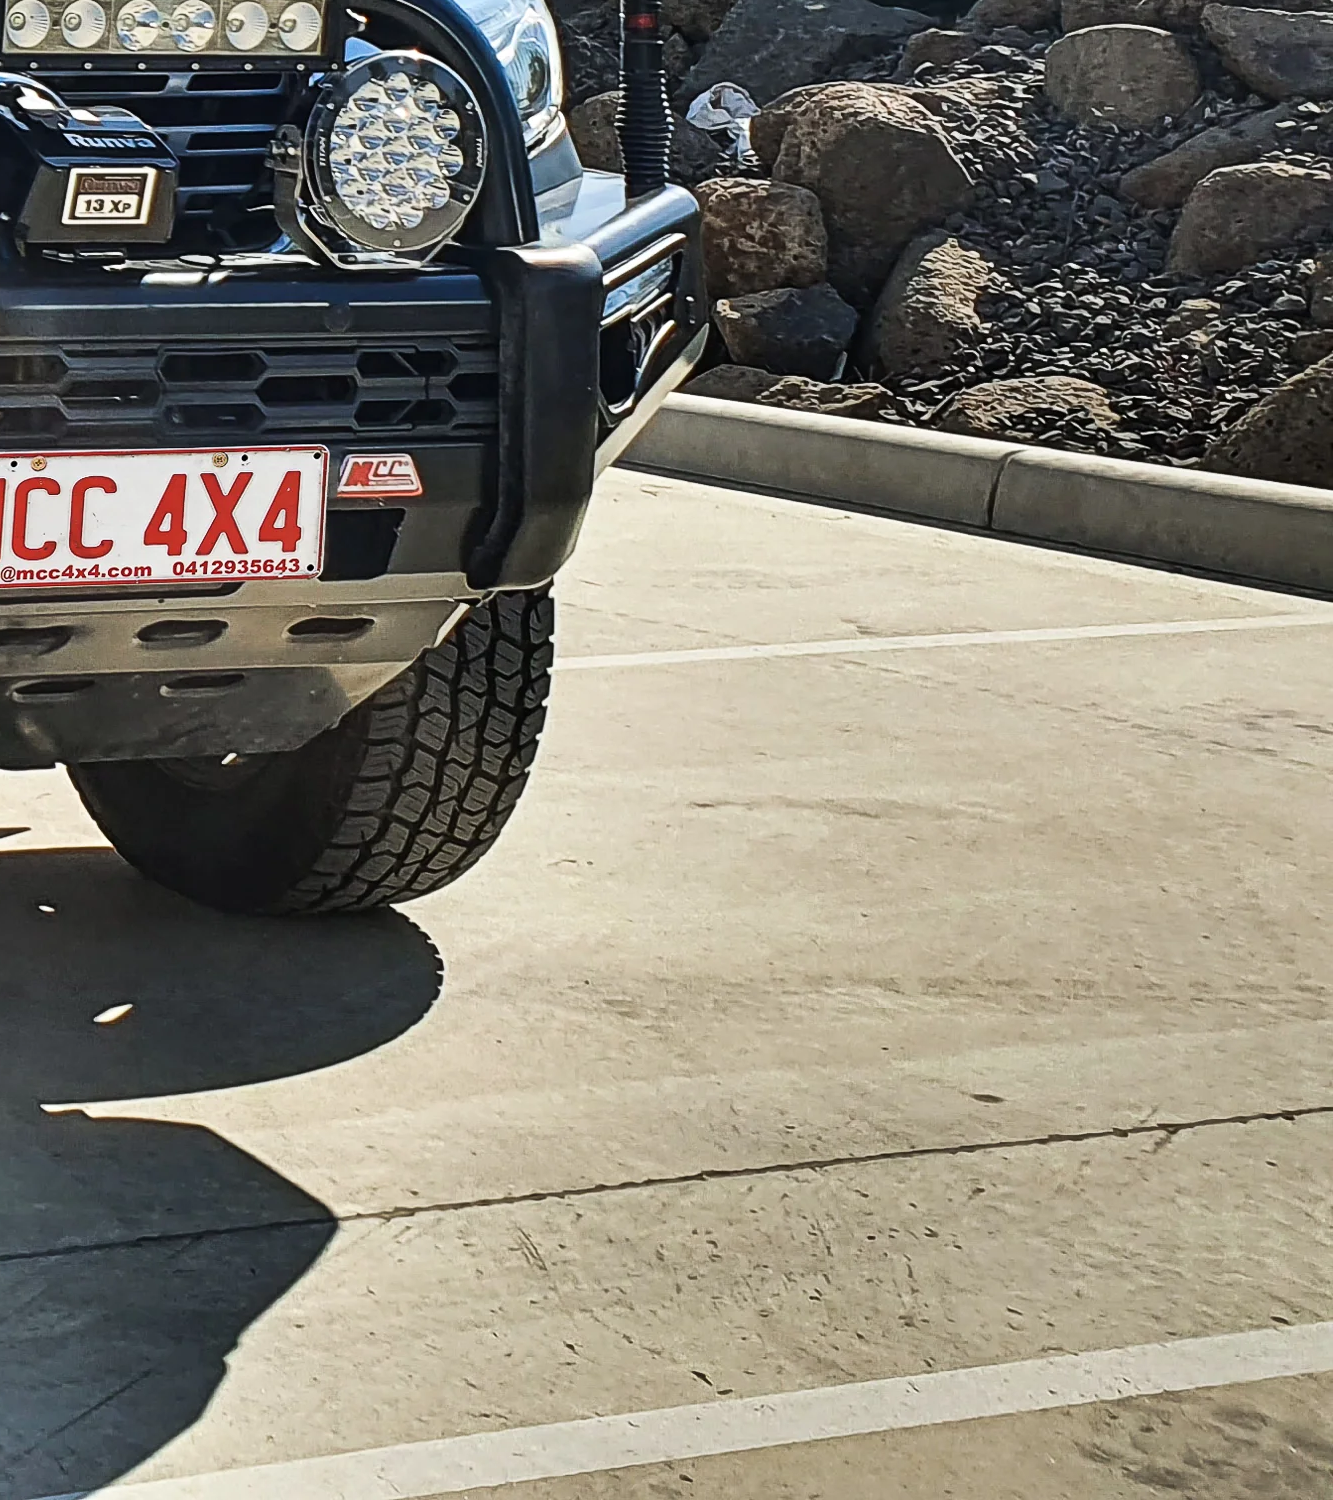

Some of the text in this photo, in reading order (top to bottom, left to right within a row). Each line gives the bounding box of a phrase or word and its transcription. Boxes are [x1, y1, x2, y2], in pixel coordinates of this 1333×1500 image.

[63, 133, 156, 148] Runva
[84, 199, 105, 212] 13
[143, 470, 302, 556] 4X4
[172, 558, 301, 576] 0412935643
